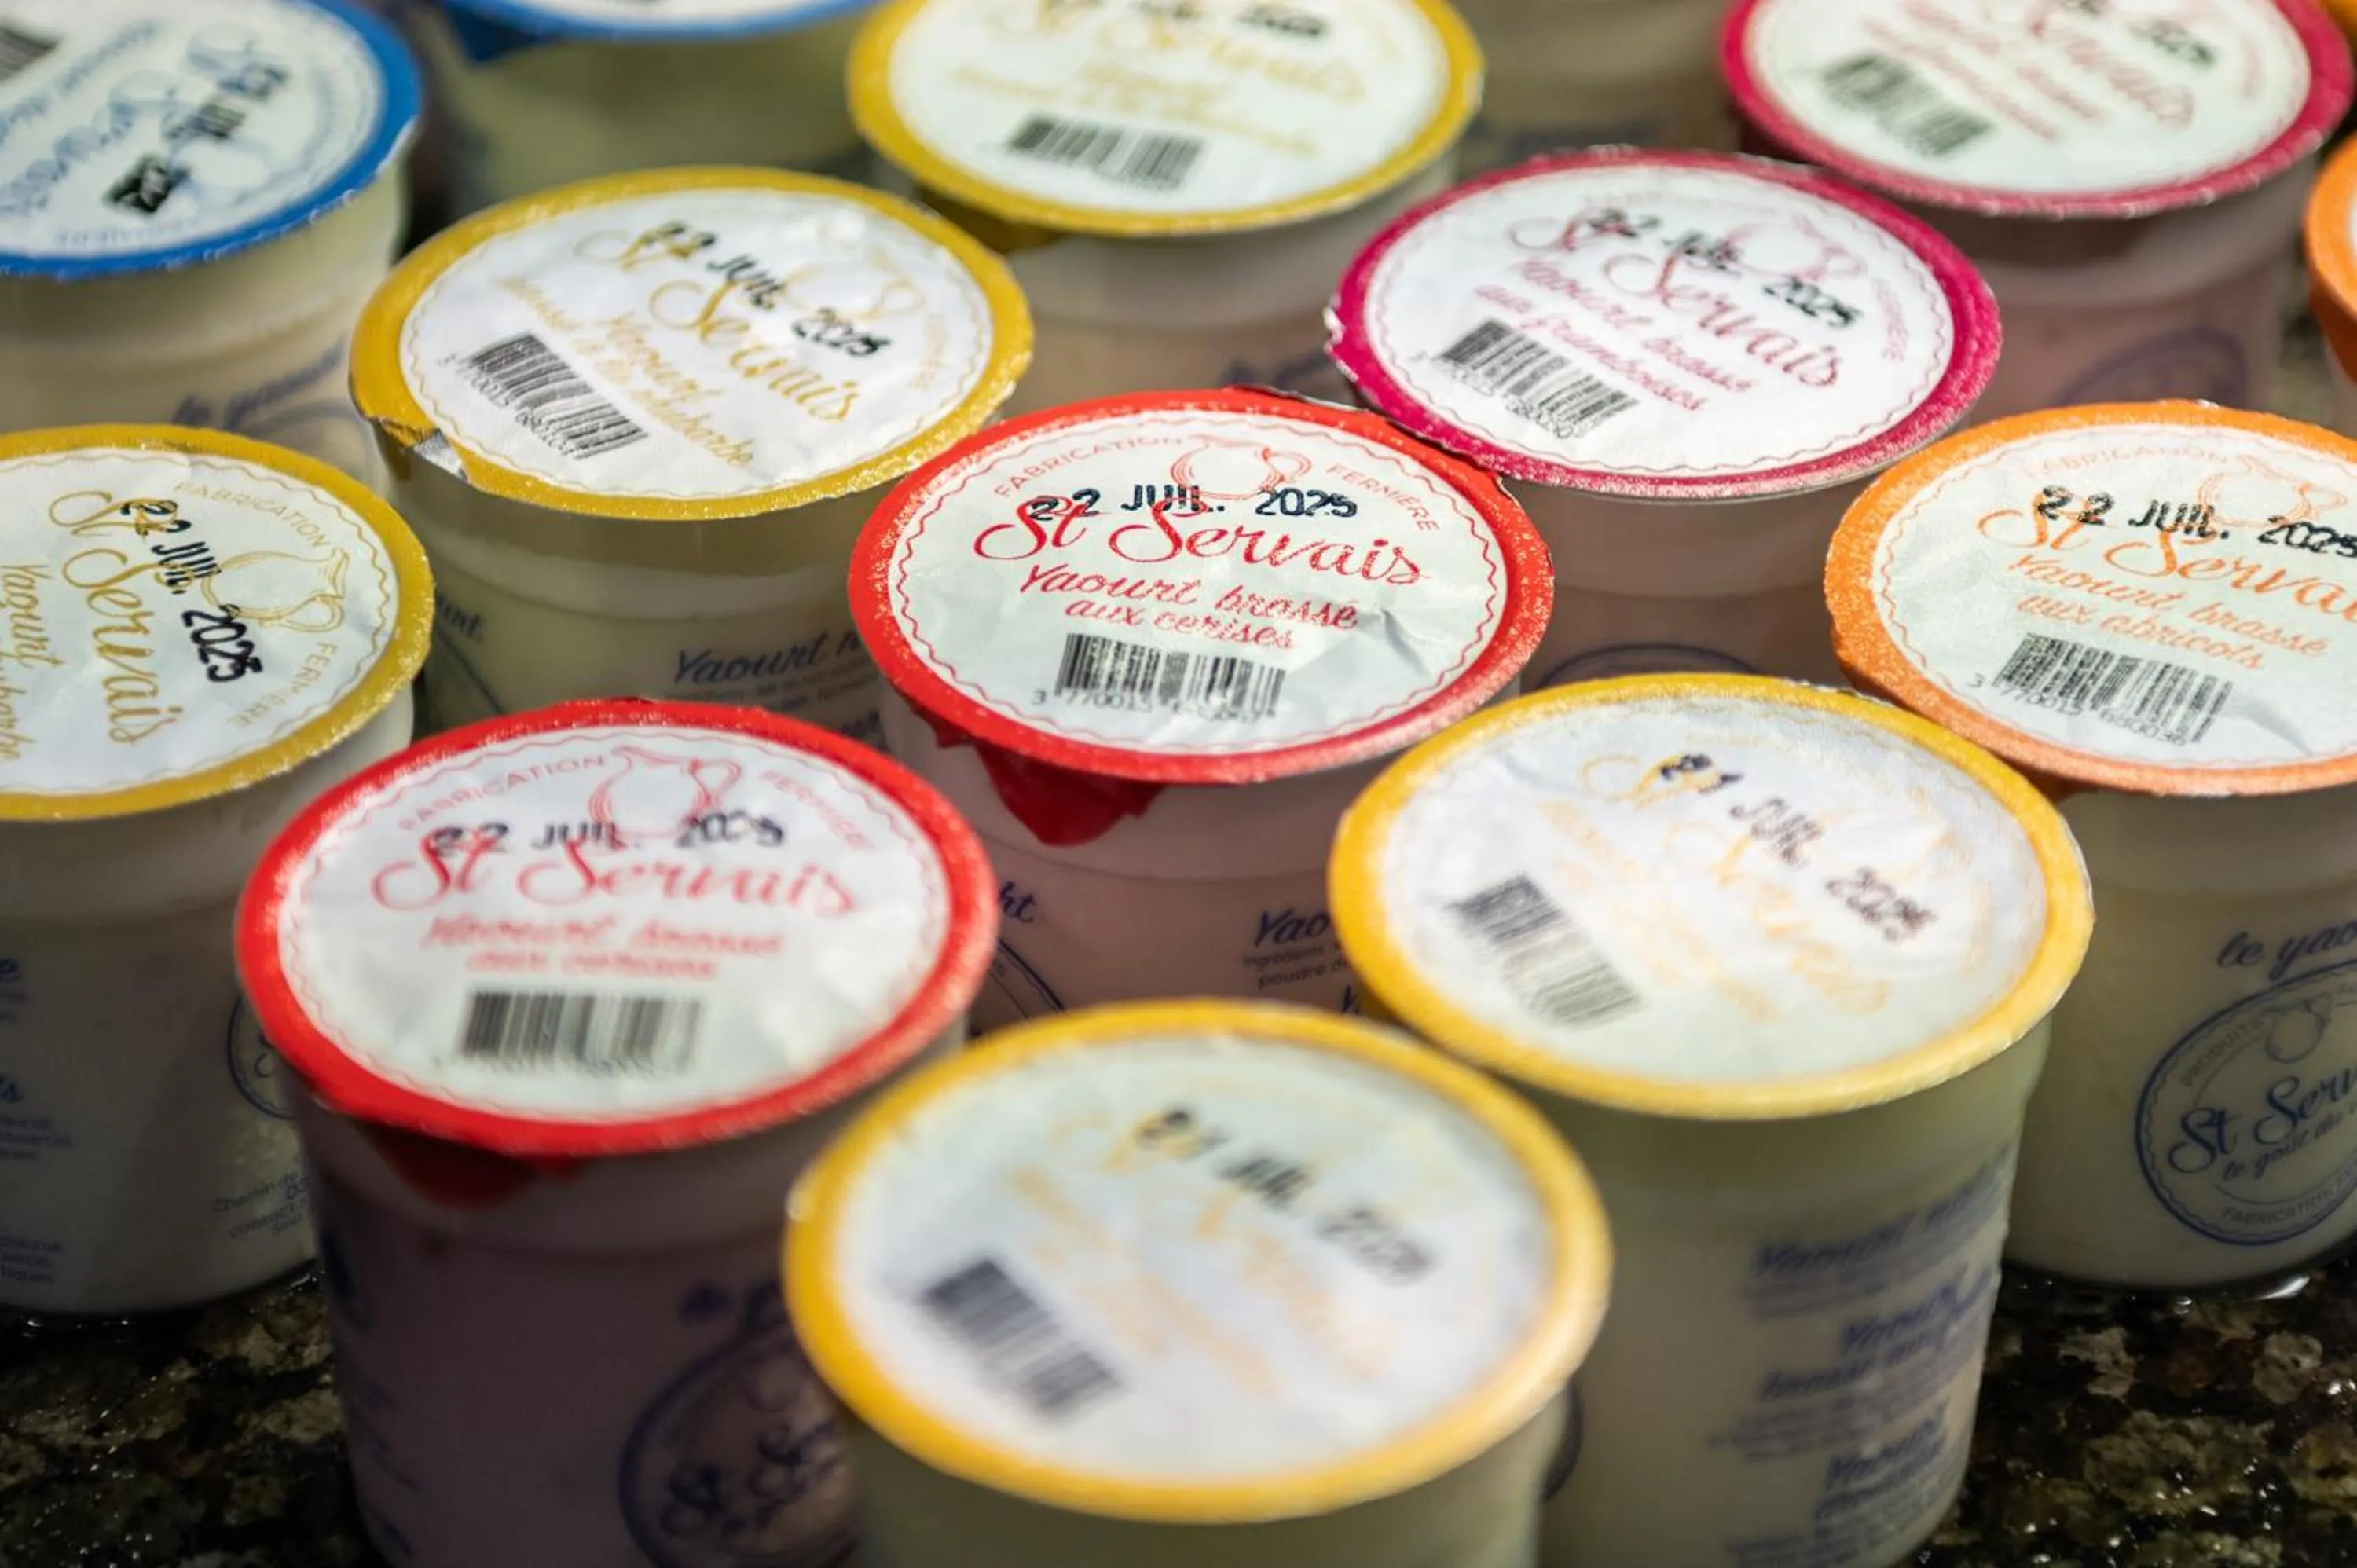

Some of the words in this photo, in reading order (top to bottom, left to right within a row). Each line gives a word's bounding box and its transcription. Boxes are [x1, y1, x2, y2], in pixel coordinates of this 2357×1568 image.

[649, 271, 860, 422] Servais
[1601, 242, 1839, 387] Servais
[993, 435, 1183, 497] FABRICATION
[174, 481, 333, 549] FABRICATION
[1255, 487, 1358, 518] 2025
[1977, 492, 2117, 550] St
[2038, 484, 2115, 526] 22
[973, 493, 1104, 561] St
[1107, 495, 1432, 585] Servais
[0, 564, 66, 669] Yaourt
[1019, 562, 1202, 605] Yaourt
[1214, 584, 1359, 631] brassé
[1065, 598, 1146, 627] aux
[1153, 610, 1294, 650] cerises
[2008, 554, 2189, 611] Yaourt
[2187, 600, 2332, 659] brassé
[63, 548, 195, 744] Servais
[181, 603, 263, 683] 2025
[673, 629, 826, 685] Yaourt
[2016, 595, 2098, 625] aux
[2099, 614, 2266, 669] abricots
[1030, 688, 1047, 706] 3
[371, 825, 509, 911] St
[514, 826, 858, 917] Servais
[1253, 907, 1331, 948] Yao
[2216, 930, 2266, 968] le
[1258, 965, 1326, 992] poudre
[2168, 1107, 2243, 1174] St
[2253, 1067, 2357, 1145] Serv
